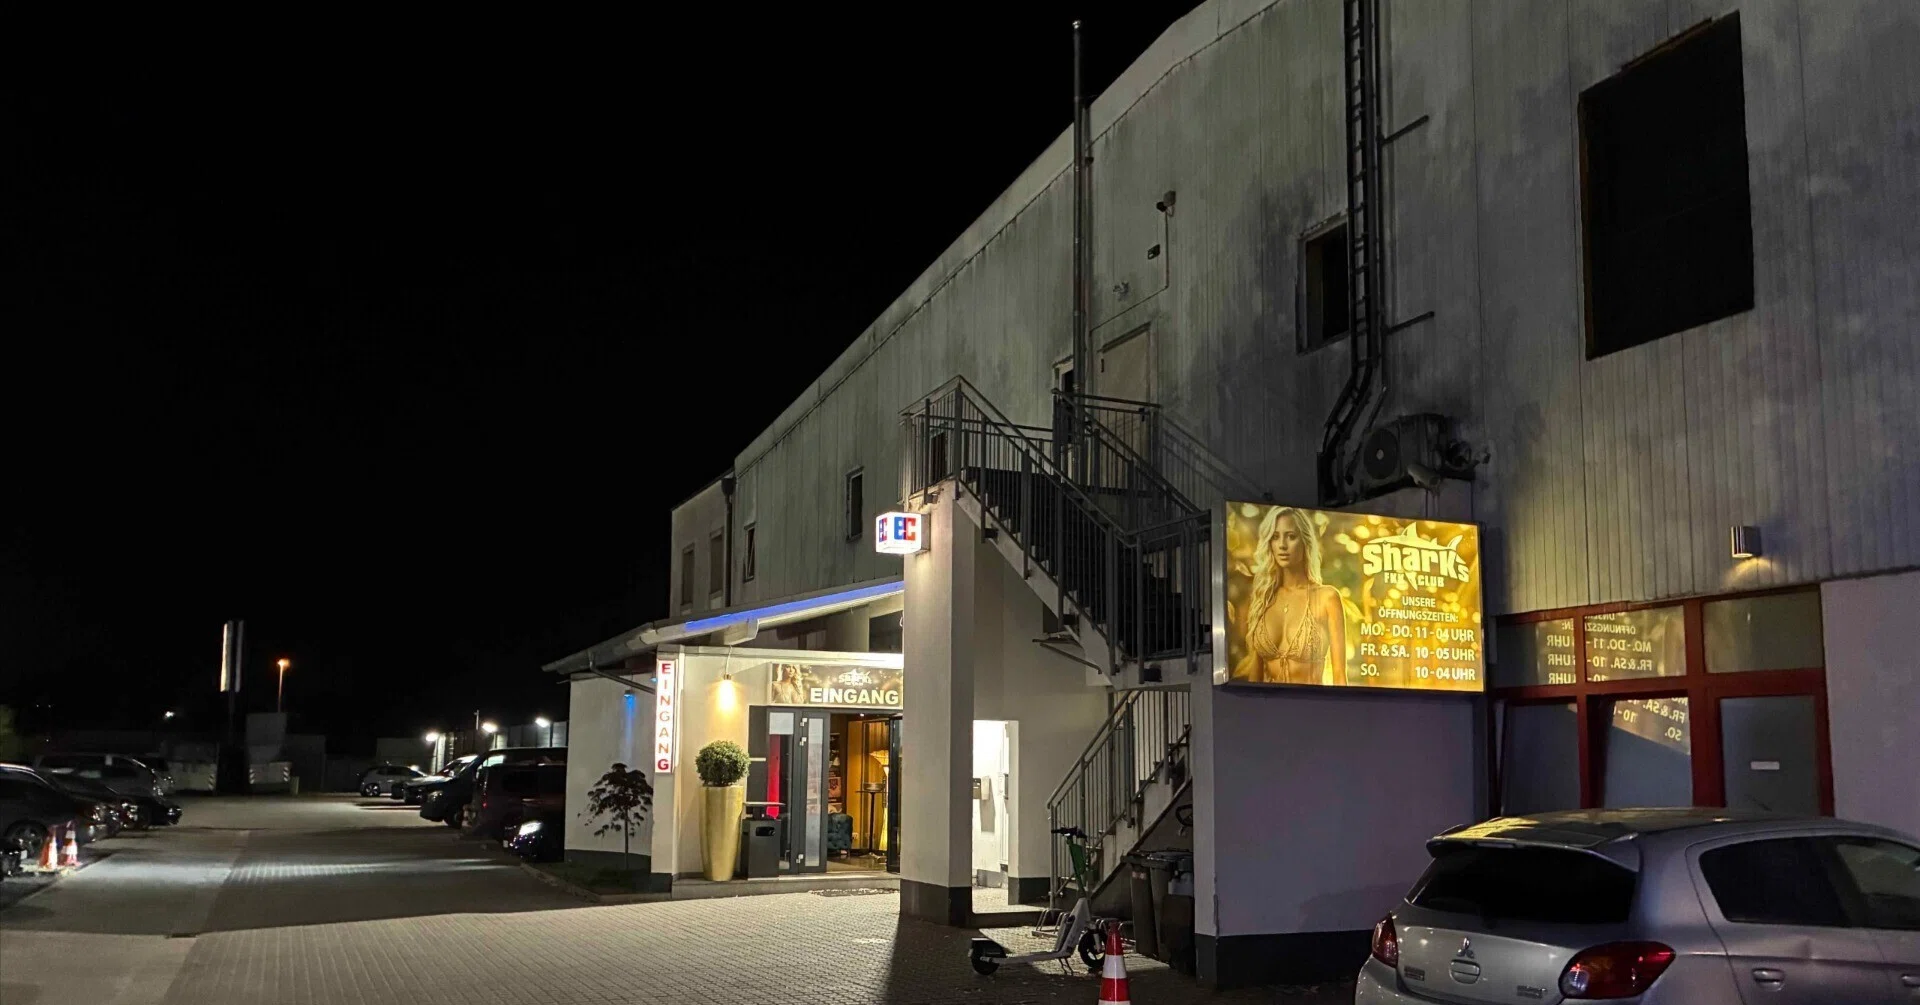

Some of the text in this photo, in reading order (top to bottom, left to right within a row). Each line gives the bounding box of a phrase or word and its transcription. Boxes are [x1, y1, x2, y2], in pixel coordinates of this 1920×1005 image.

[894, 516, 916, 541] EC
[1384, 572, 1444, 587] FKK CLUB
[1402, 596, 1436, 607] UNSERE
[1379, 606, 1458, 622] ÖFFNUNGSZEITEN:
[1415, 627, 1427, 638] 11
[1436, 628, 1449, 640] 04
[1451, 629, 1474, 642] UHR
[1361, 643, 1378, 656] FR.
[1380, 644, 1389, 656] &
[1391, 645, 1410, 657] SA.
[1415, 647, 1429, 658] 10
[1436, 648, 1449, 659] 05
[1451, 648, 1475, 661] UHR
[1361, 664, 1380, 676] SO.
[1415, 667, 1429, 678] 10
[1436, 667, 1450, 679] 04
[1452, 668, 1476, 680] UHR
[810, 687, 899, 705] EINGANG
[657, 663, 672, 771] EINGANG
